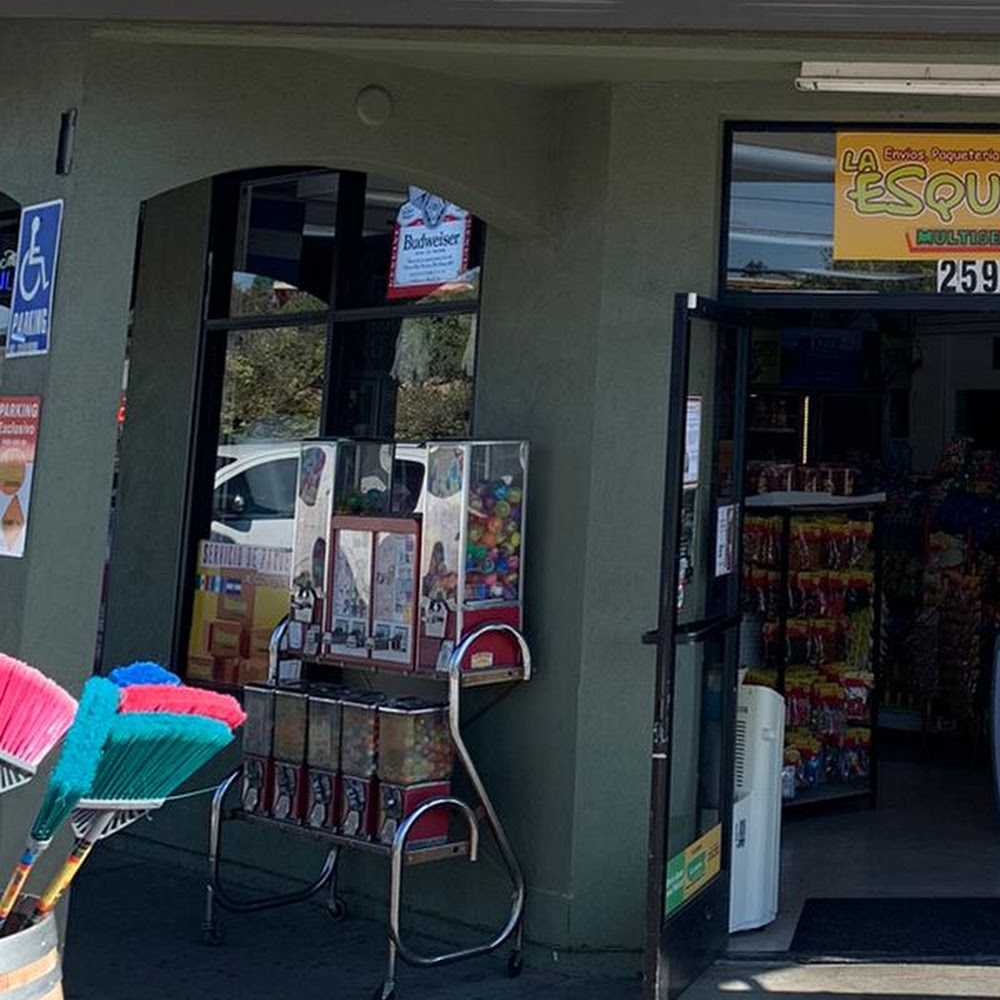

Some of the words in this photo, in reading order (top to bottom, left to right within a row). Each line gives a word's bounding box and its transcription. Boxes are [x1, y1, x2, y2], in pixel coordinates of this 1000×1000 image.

[842, 148, 877, 172] LA
[403, 231, 460, 251] Budweiser
[12, 308, 48, 334] PARKING
